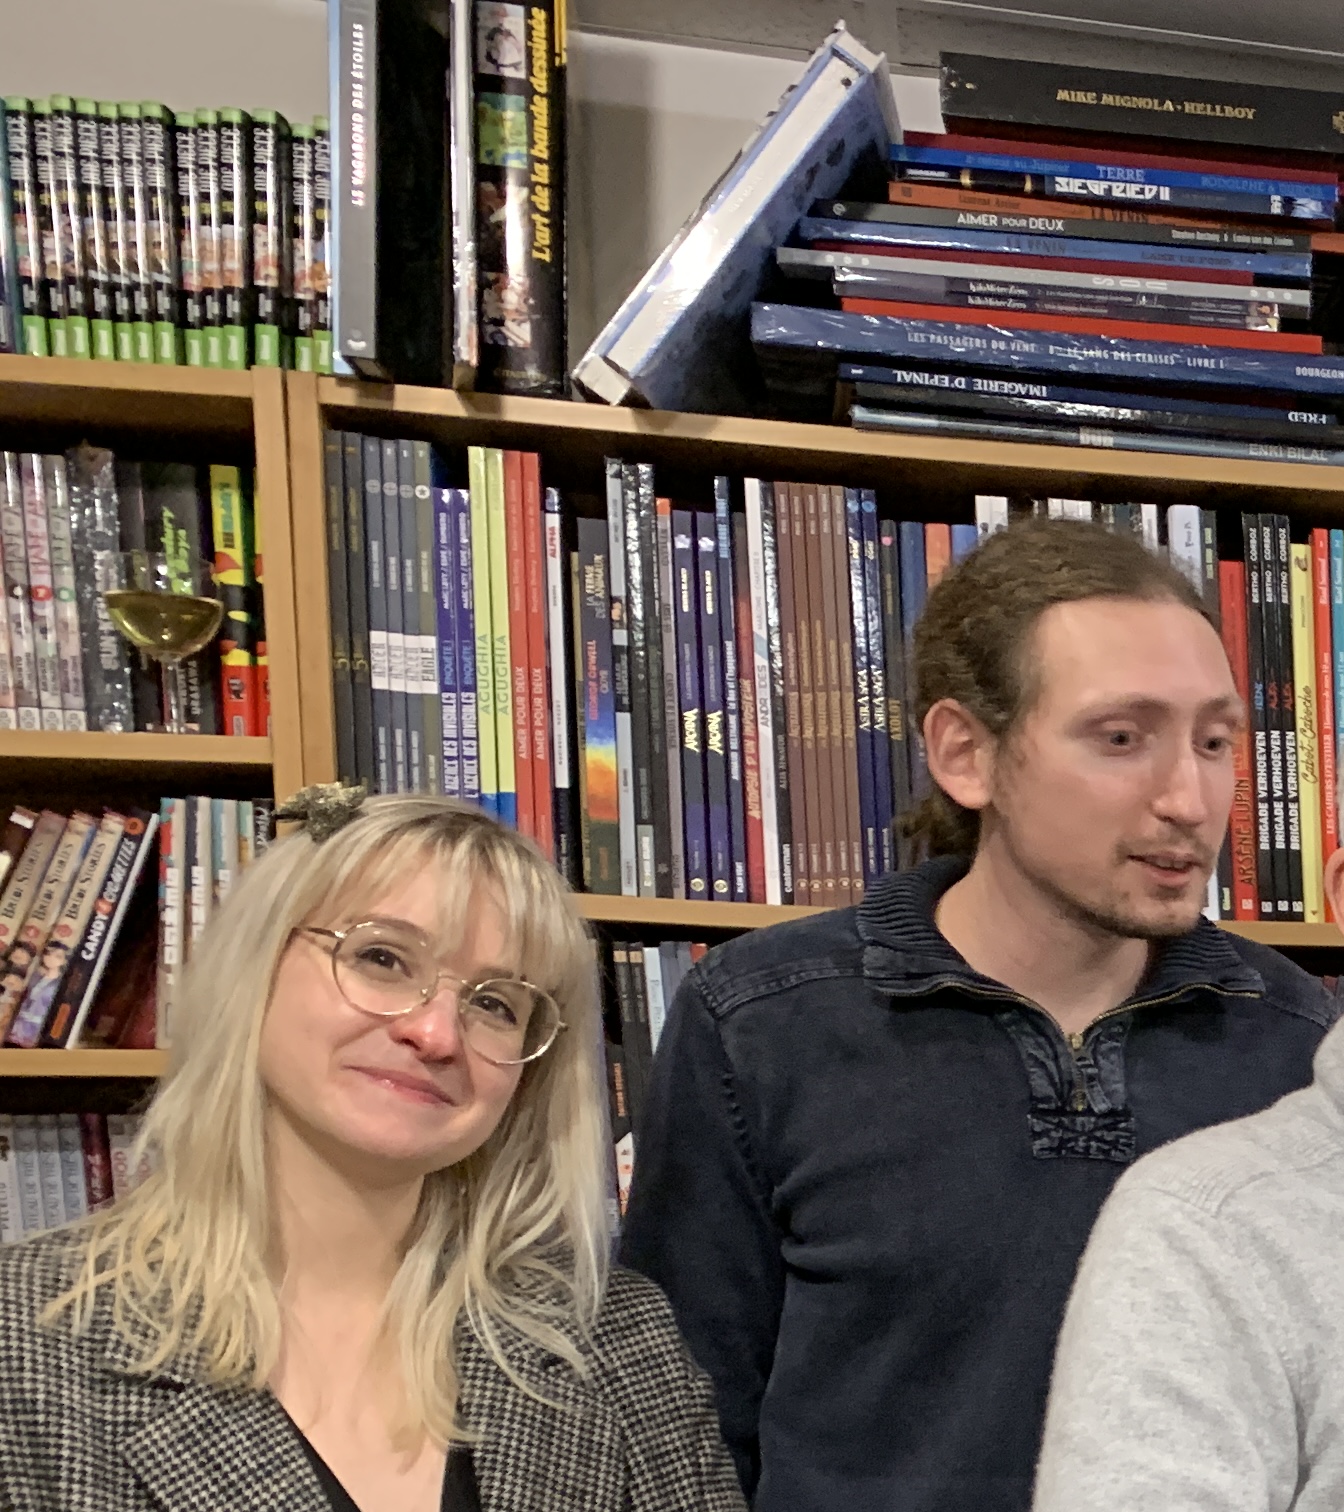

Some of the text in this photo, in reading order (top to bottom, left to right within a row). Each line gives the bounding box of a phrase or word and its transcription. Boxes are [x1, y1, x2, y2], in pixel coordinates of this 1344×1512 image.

[350, 23, 364, 208] LE VAGABOND DES ÉTOILES
[1055, 88, 1098, 105] MIKE
[526, 6, 551, 263] L'art de la bande dessinée
[956, 213, 1065, 232] AIMER POUR DEUX
[891, 368, 1048, 398] IMAGERIE D'EPINAL
[1287, 410, 1328, 425] FRED
[547, 526, 558, 559] ALPHA
[514, 666, 528, 760] AIMER POUR DEUX
[682, 707, 700, 753] ARCANA
[707, 709, 724, 755] ARCANA
[1255, 731, 1271, 851] BRIGADE VERHOEVEN
[1270, 730, 1286, 849] BRIGADE VERHOEVEN
[1285, 731, 1301, 851] BRIGADE VERHOEVEN
[81, 912, 109, 961] CANDY
